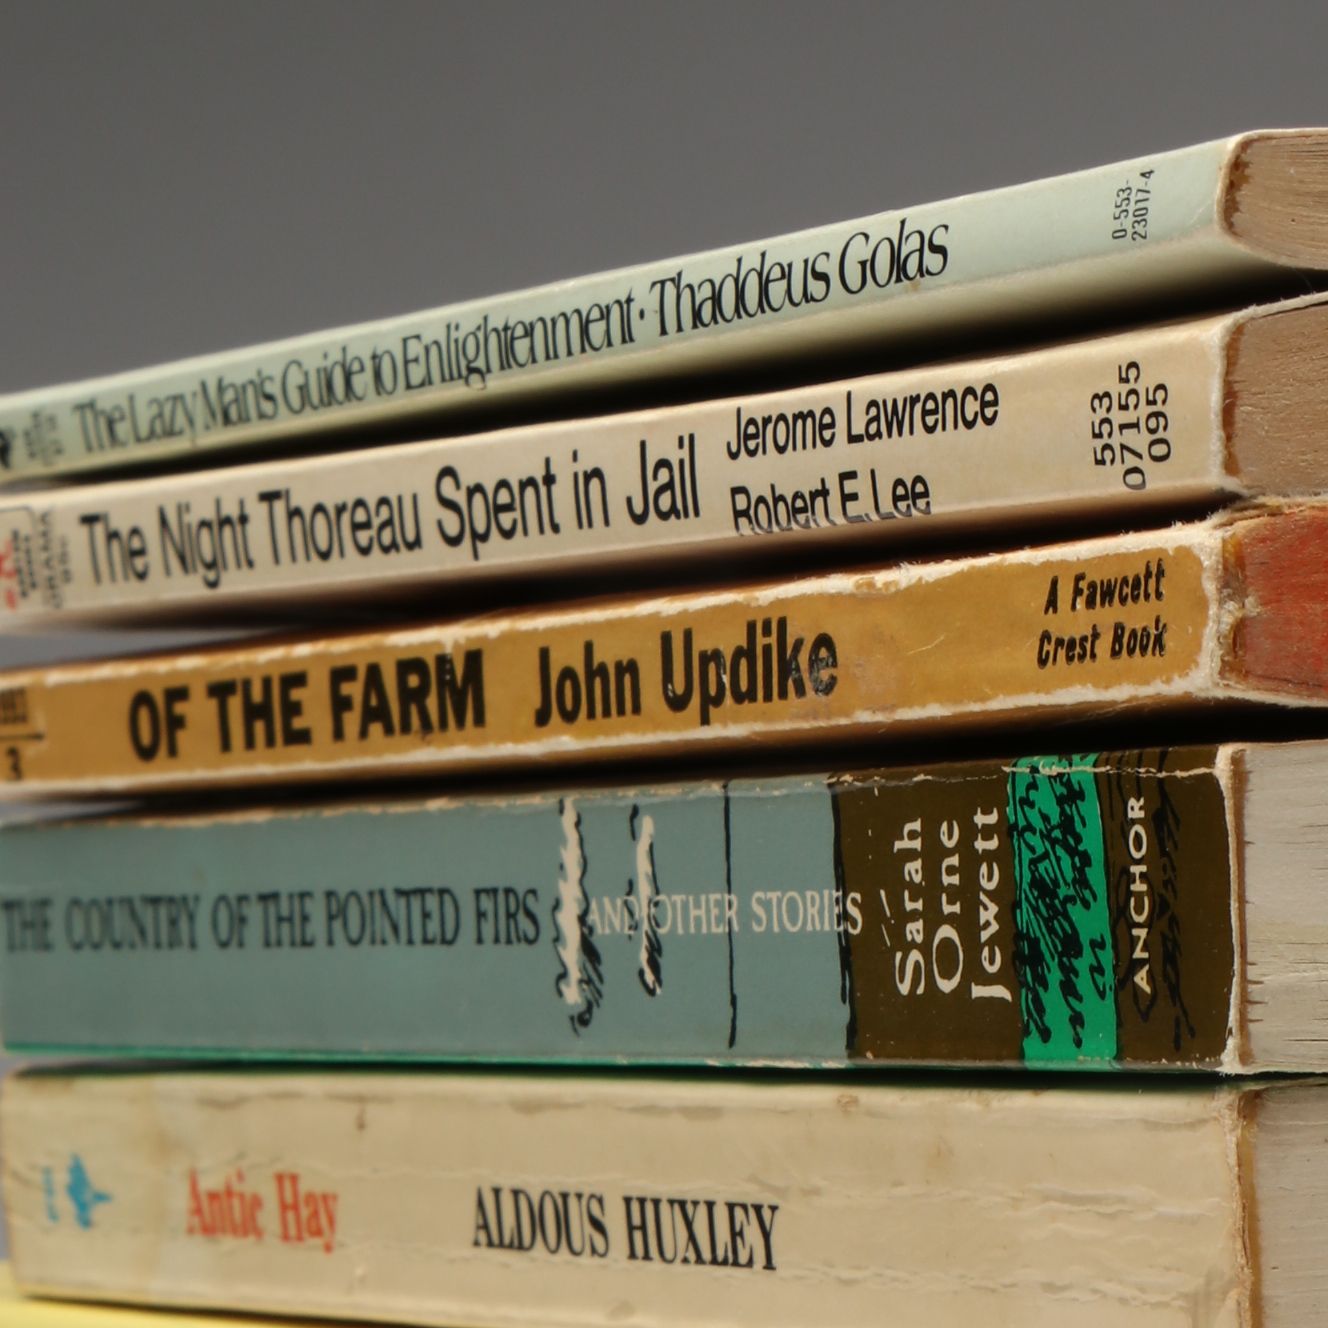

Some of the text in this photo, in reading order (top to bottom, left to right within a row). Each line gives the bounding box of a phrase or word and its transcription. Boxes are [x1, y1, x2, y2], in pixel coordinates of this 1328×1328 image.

[1112, 179, 1134, 241] 0-553-
[1131, 169, 1155, 243] 23017-4
[71, 397, 127, 453] The
[129, 391, 198, 449] Lazy
[281, 345, 366, 415] Guide
[371, 346, 398, 397] to
[402, 287, 638, 392] Enlightenment
[650, 249, 831, 339] Thaddeus
[837, 216, 950, 297] Golas
[726, 382, 999, 461] Jerome Lawrence
[1090, 390, 1116, 467] 553
[1118, 360, 1147, 491] 07155
[1145, 383, 1172, 463] 095
[81, 512, 149, 587] The
[159, 502, 255, 589] Night
[258, 488, 423, 566] Thoreau
[435, 456, 560, 561] Spent
[571, 449, 610, 533] in
[626, 432, 701, 527] Jail
[730, 477, 837, 537] Robert
[870, 468, 932, 521] Lee
[1043, 558, 1165, 614] A Fawcett
[533, 615, 839, 727] John Updike
[1037, 615, 1167, 668] Crest Book
[129, 648, 486, 762] OF THE FARM
[2, 886, 541, 953] THE COUNTRY OF THE POINTED FIRS
[587, 890, 864, 937] AND OTHER STORIES
[893, 817, 926, 998] Sarah
[930, 817, 965, 996] Orne
[970, 805, 1012, 1003] Jewett
[1127, 796, 1151, 994] ANCHOR
[185, 1166, 339, 1255] Antic Hay
[472, 1185, 780, 1272] ALDOUS HUXLEY
